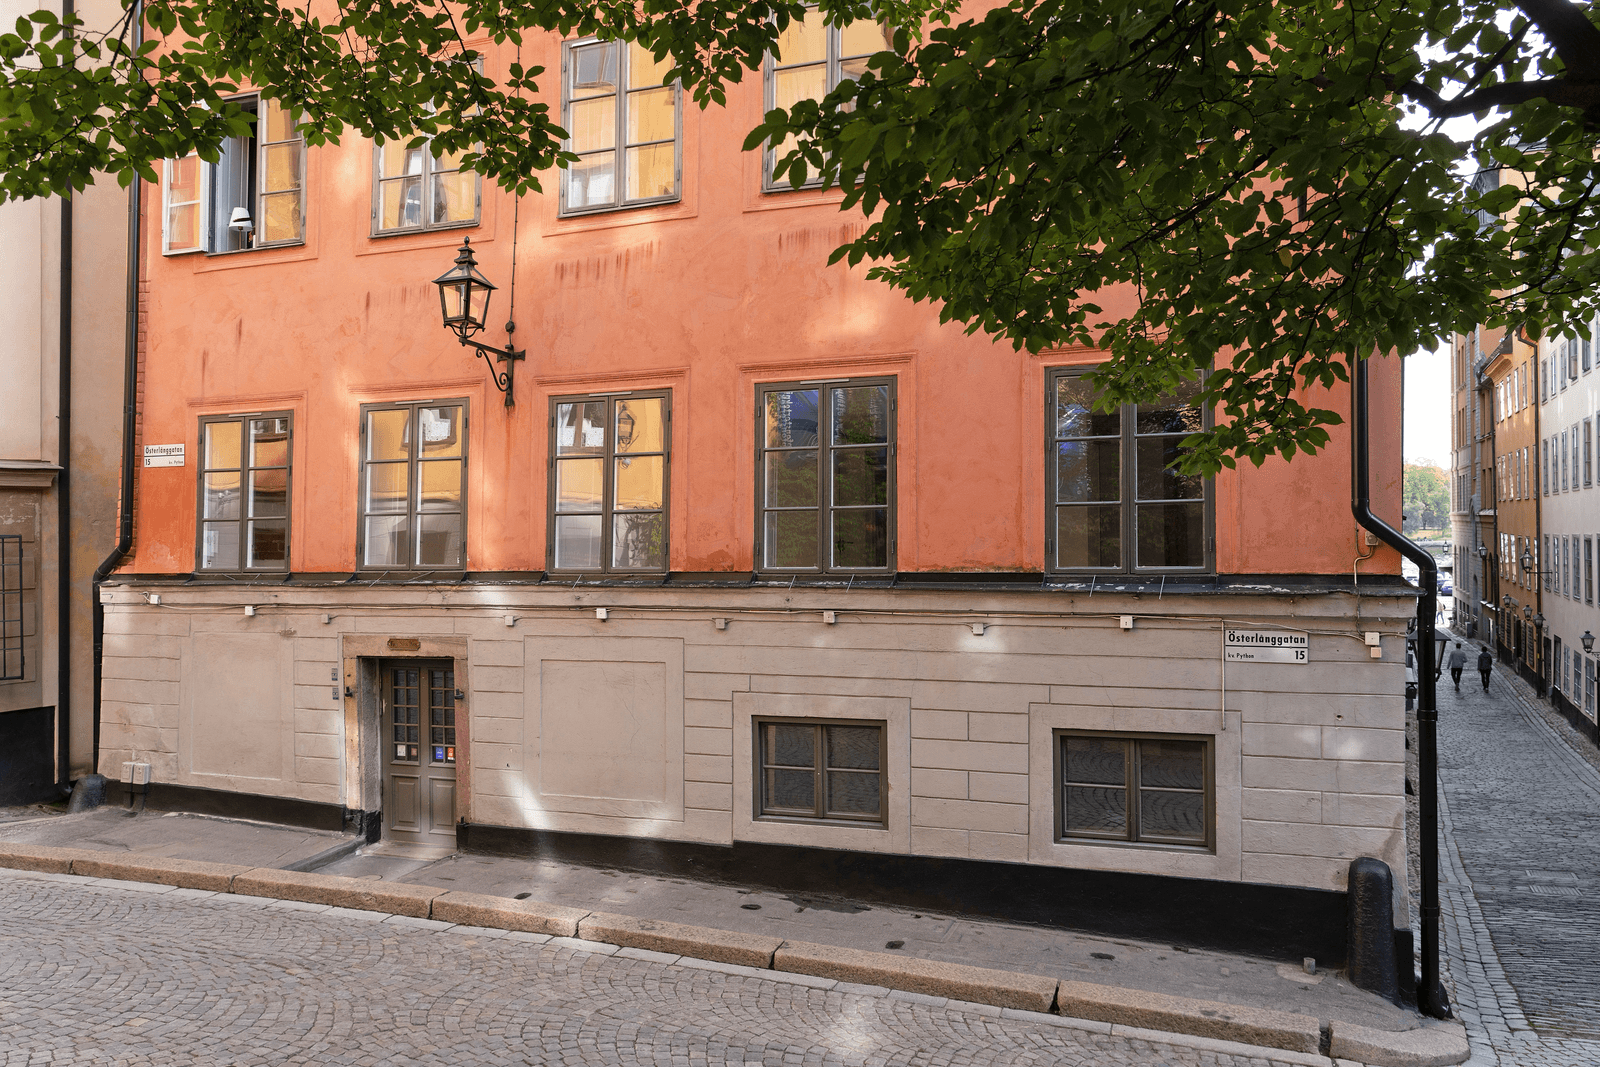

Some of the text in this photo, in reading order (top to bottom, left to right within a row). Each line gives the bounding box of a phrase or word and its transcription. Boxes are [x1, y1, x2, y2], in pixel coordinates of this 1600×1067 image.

[145, 446, 183, 455] Österlånggatan
[145, 458, 151, 466] 15
[1228, 630, 1306, 646] Österlånggatan
[1295, 650, 1305, 660] 15
